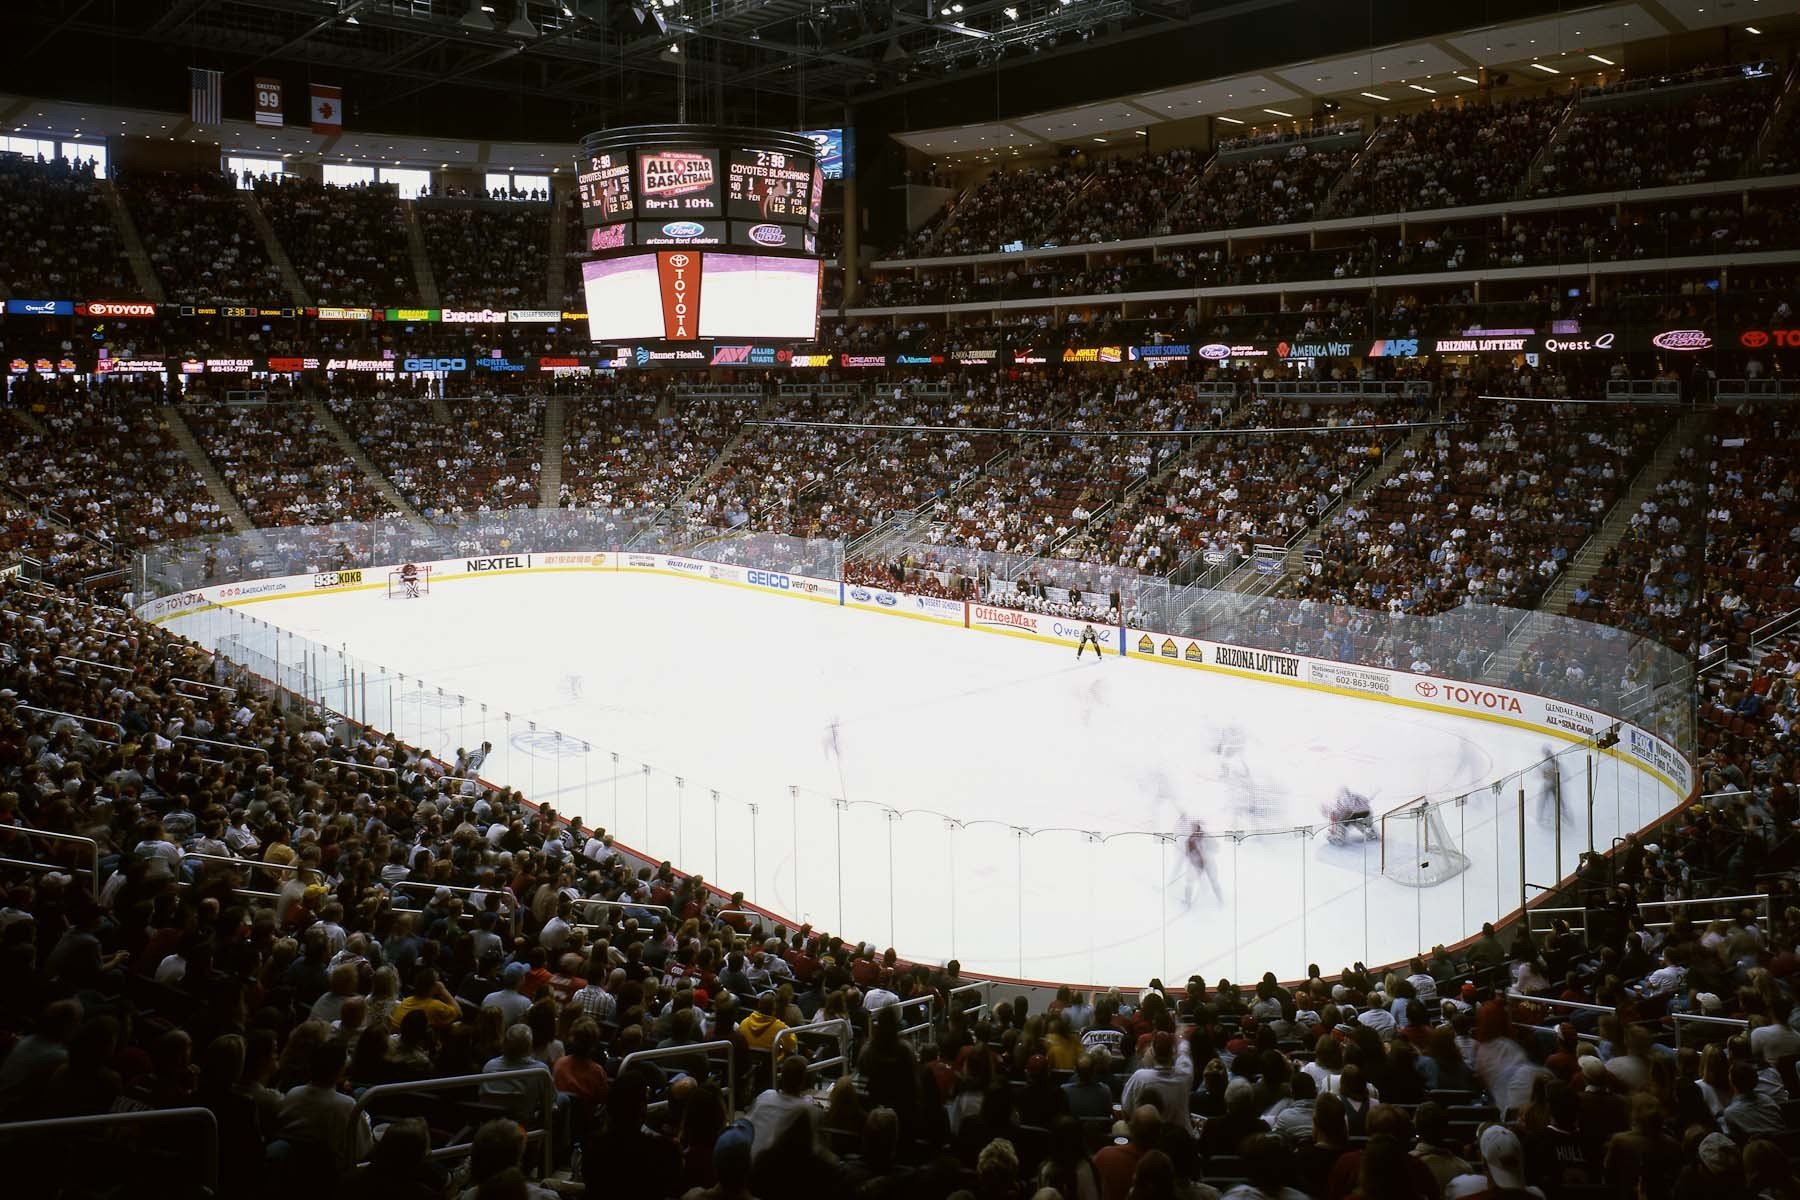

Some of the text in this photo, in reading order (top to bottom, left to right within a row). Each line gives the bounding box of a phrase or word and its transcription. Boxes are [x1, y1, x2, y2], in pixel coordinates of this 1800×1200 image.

[259, 91, 279, 108] 99
[647, 160, 710, 175] ALL STAR
[731, 164, 768, 177] COYOTES
[769, 168, 810, 182] BLACKHAWKS
[579, 171, 601, 184] COYOTES
[647, 173, 712, 189] BASKETBALL
[730, 174, 743, 182] SOG
[748, 177, 754, 191] 1
[786, 182, 792, 195] 1
[767, 187, 773, 196] 4
[797, 189, 806, 198] 24
[610, 204, 618, 213] 12
[646, 199, 714, 209] April 10th
[774, 204, 785, 213] 12
[670, 224, 696, 235] Ford
[646, 237, 719, 247] arizona ford dealers
[754, 233, 784, 242] LIGHT
[106, 305, 155, 315] TOYOTA
[674, 269, 687, 338] TOYOTA
[442, 309, 507, 323] ExecuCar
[1141, 345, 1190, 355] DESERT SCHOOLS
[1205, 347, 1225, 356] Ford
[1290, 342, 1351, 357] AMERICA WEST
[1380, 339, 1418, 356] APS
[1436, 339, 1524, 351] ARIZONA LOTTERY
[1545, 339, 1592, 352] Qwest
[650, 351, 675, 360] Banner
[1075, 348, 1099, 356] ASHLEY
[346, 360, 394, 370] MORTGAGE
[404, 358, 466, 371] GEICO
[476, 358, 509, 367] NORTEL
[791, 354, 832, 367] SUBWAY
[490, 364, 526, 372] NETWORKS
[467, 556, 524, 572] NEXTEL
[668, 560, 703, 573] BUD LIGHT
[338, 571, 362, 584] KDKB
[747, 570, 789, 589] GEICO
[792, 581, 818, 593] verizon
[166, 592, 205, 611] TOYOTA
[925, 598, 961, 612] DESERT SCHOOLS
[975, 606, 1037, 629] OfficeMax
[1215, 647, 1299, 677] ARIZONA LOTTERY
[1312, 665, 1389, 684] National SHERYL JENNINGS
[1442, 685, 1522, 714] TOYOTA
[1545, 703, 1574, 717] GLENDALE
[1574, 711, 1594, 725] ARENA
[1546, 716, 1559, 726] ALL
[1561, 720, 1576, 731] STAR
[1576, 724, 1594, 736] GAME
[1635, 732, 1652, 754] FOX
